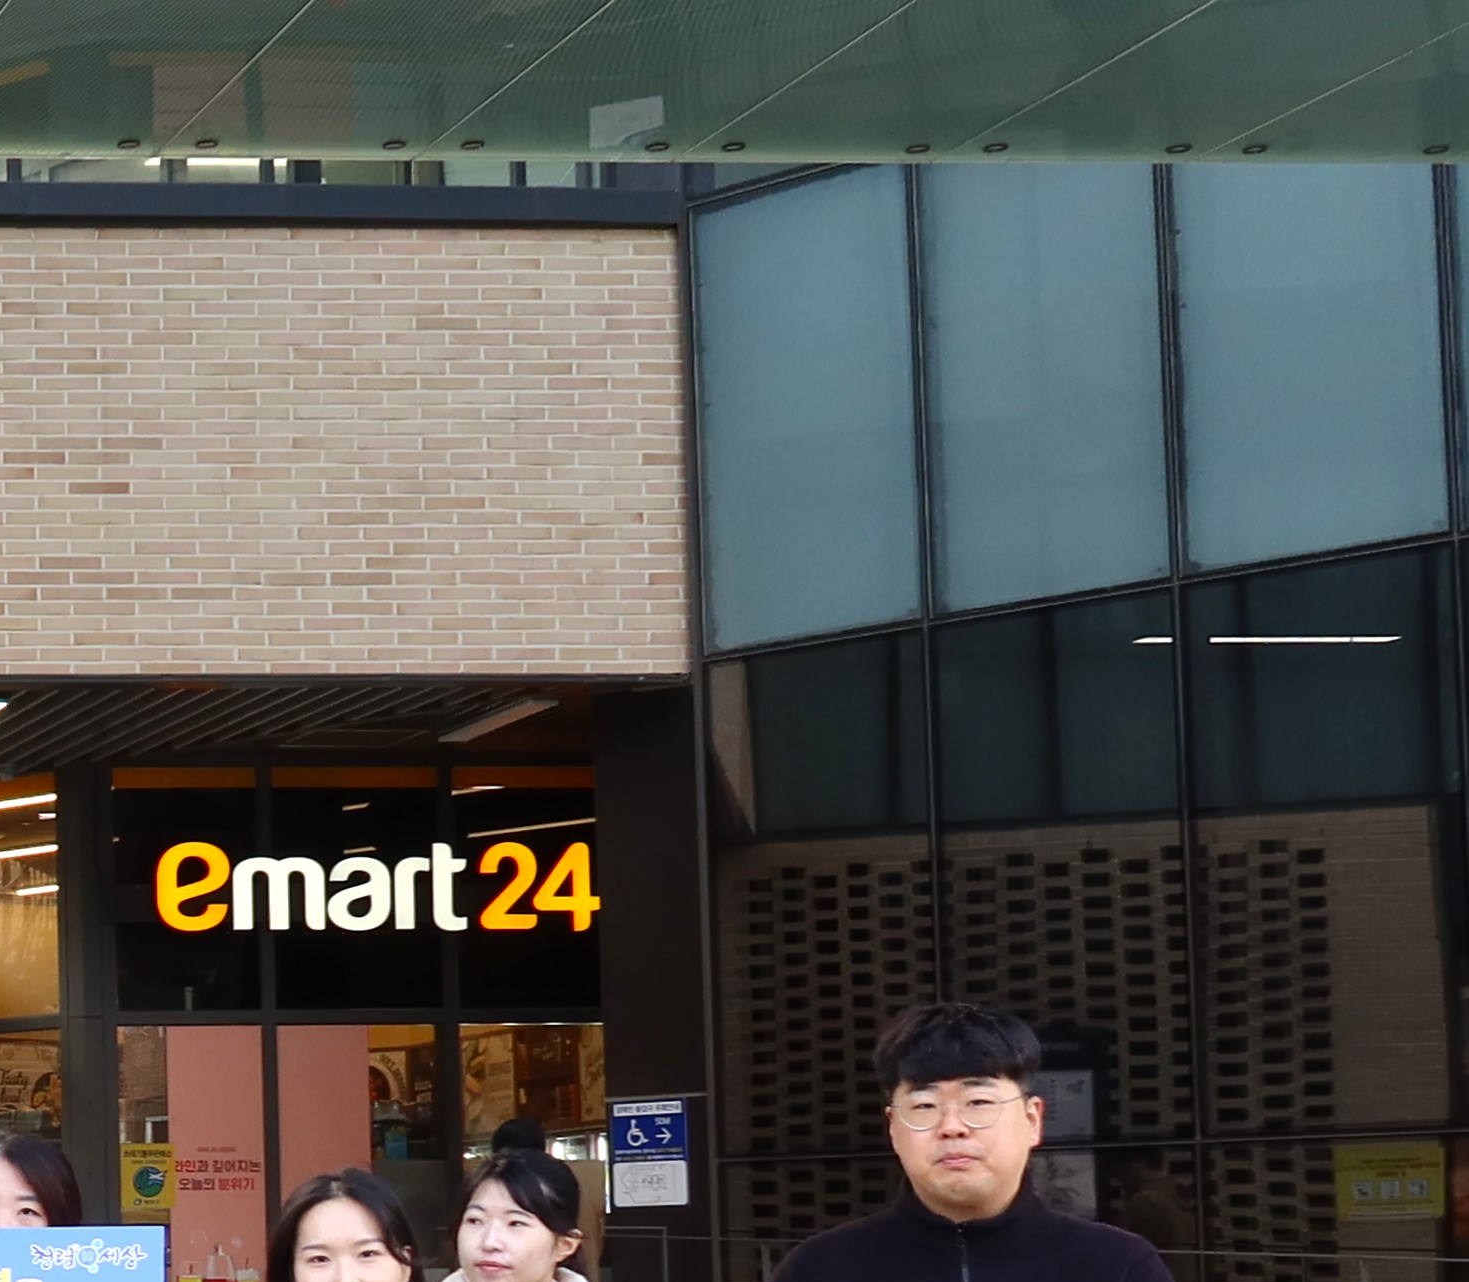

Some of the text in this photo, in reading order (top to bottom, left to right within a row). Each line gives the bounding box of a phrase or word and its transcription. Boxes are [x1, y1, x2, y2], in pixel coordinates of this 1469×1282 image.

[154, 841, 602, 933] emart24
[212, 1160, 262, 1173] 깊어지는
[178, 1177, 255, 1191] 오늘의 분위기
